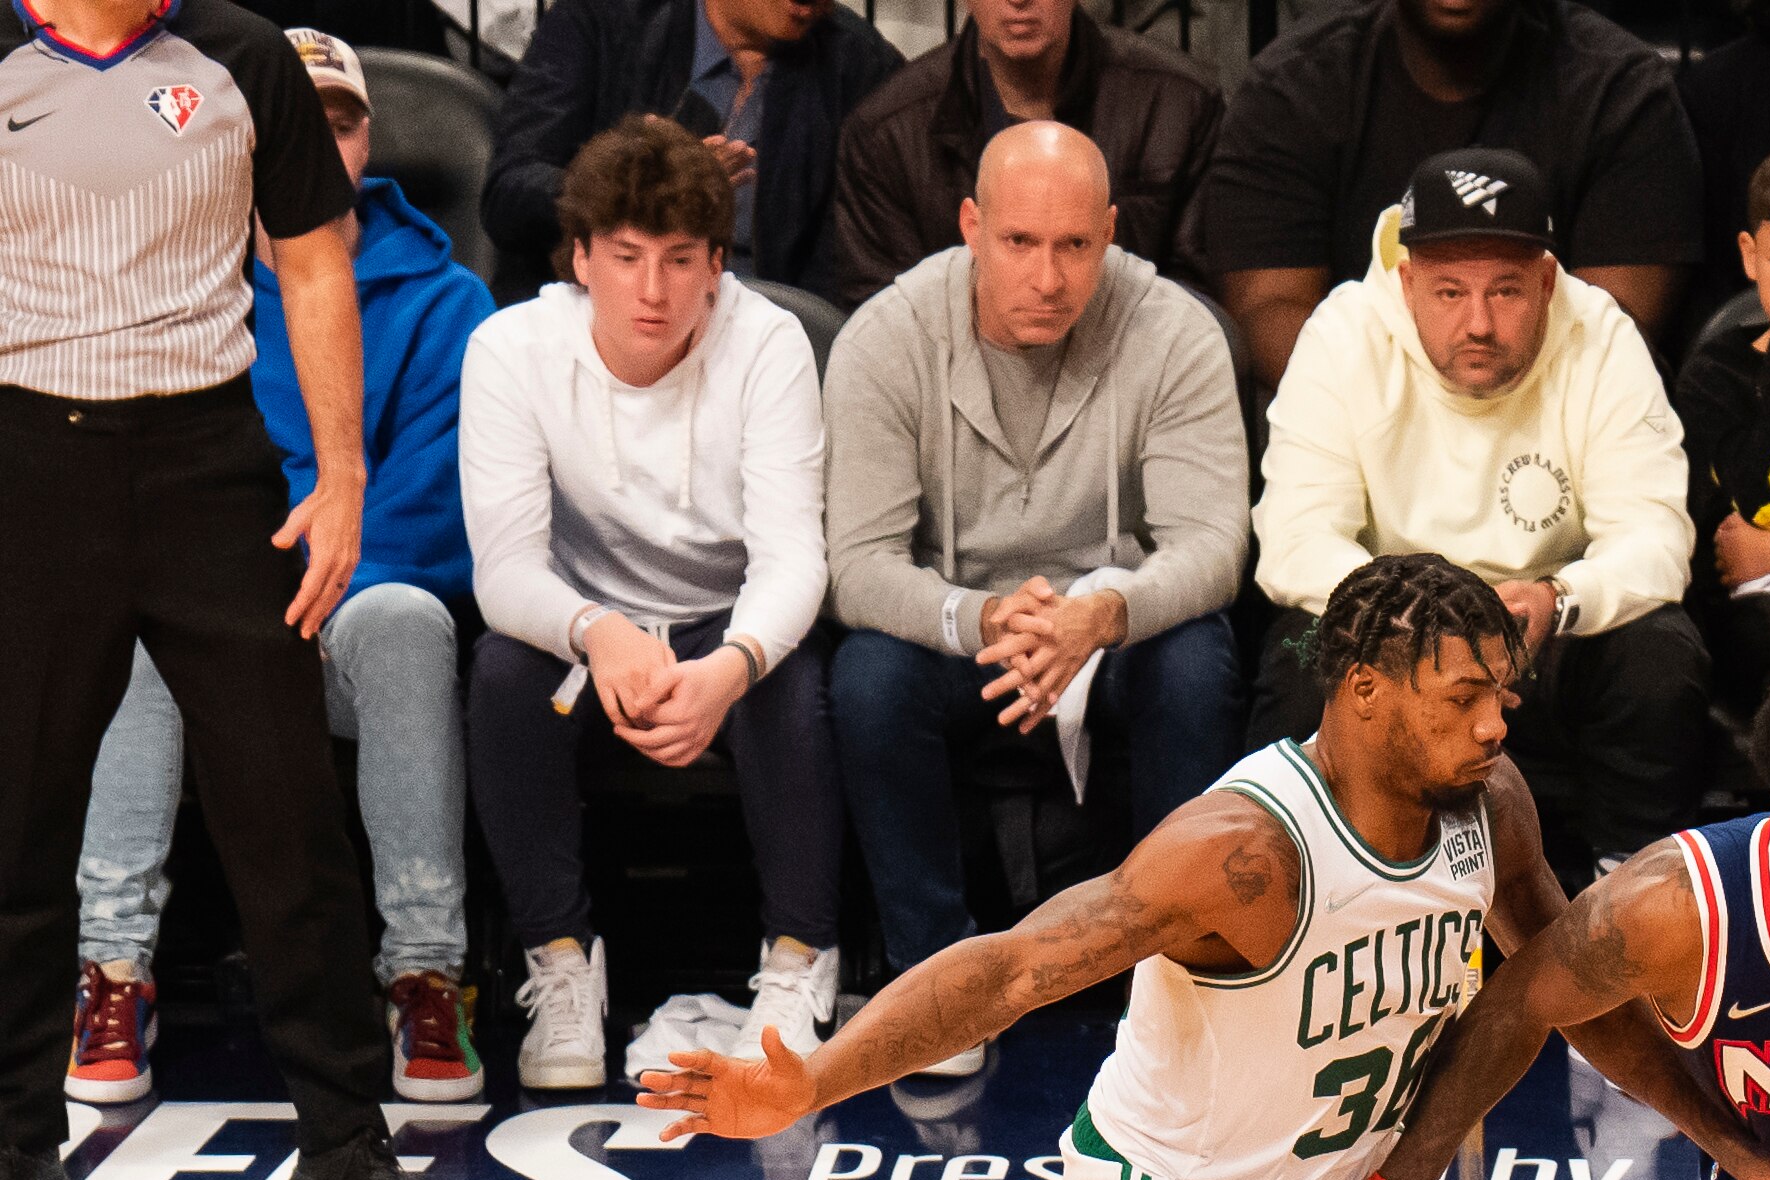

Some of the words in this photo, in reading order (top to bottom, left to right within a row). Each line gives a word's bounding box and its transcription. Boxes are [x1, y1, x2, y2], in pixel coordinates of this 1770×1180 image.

[1443, 829, 1483, 863] VISTA
[1450, 851, 1485, 881] PRINT
[1296, 909, 1482, 1049] CELTICS
